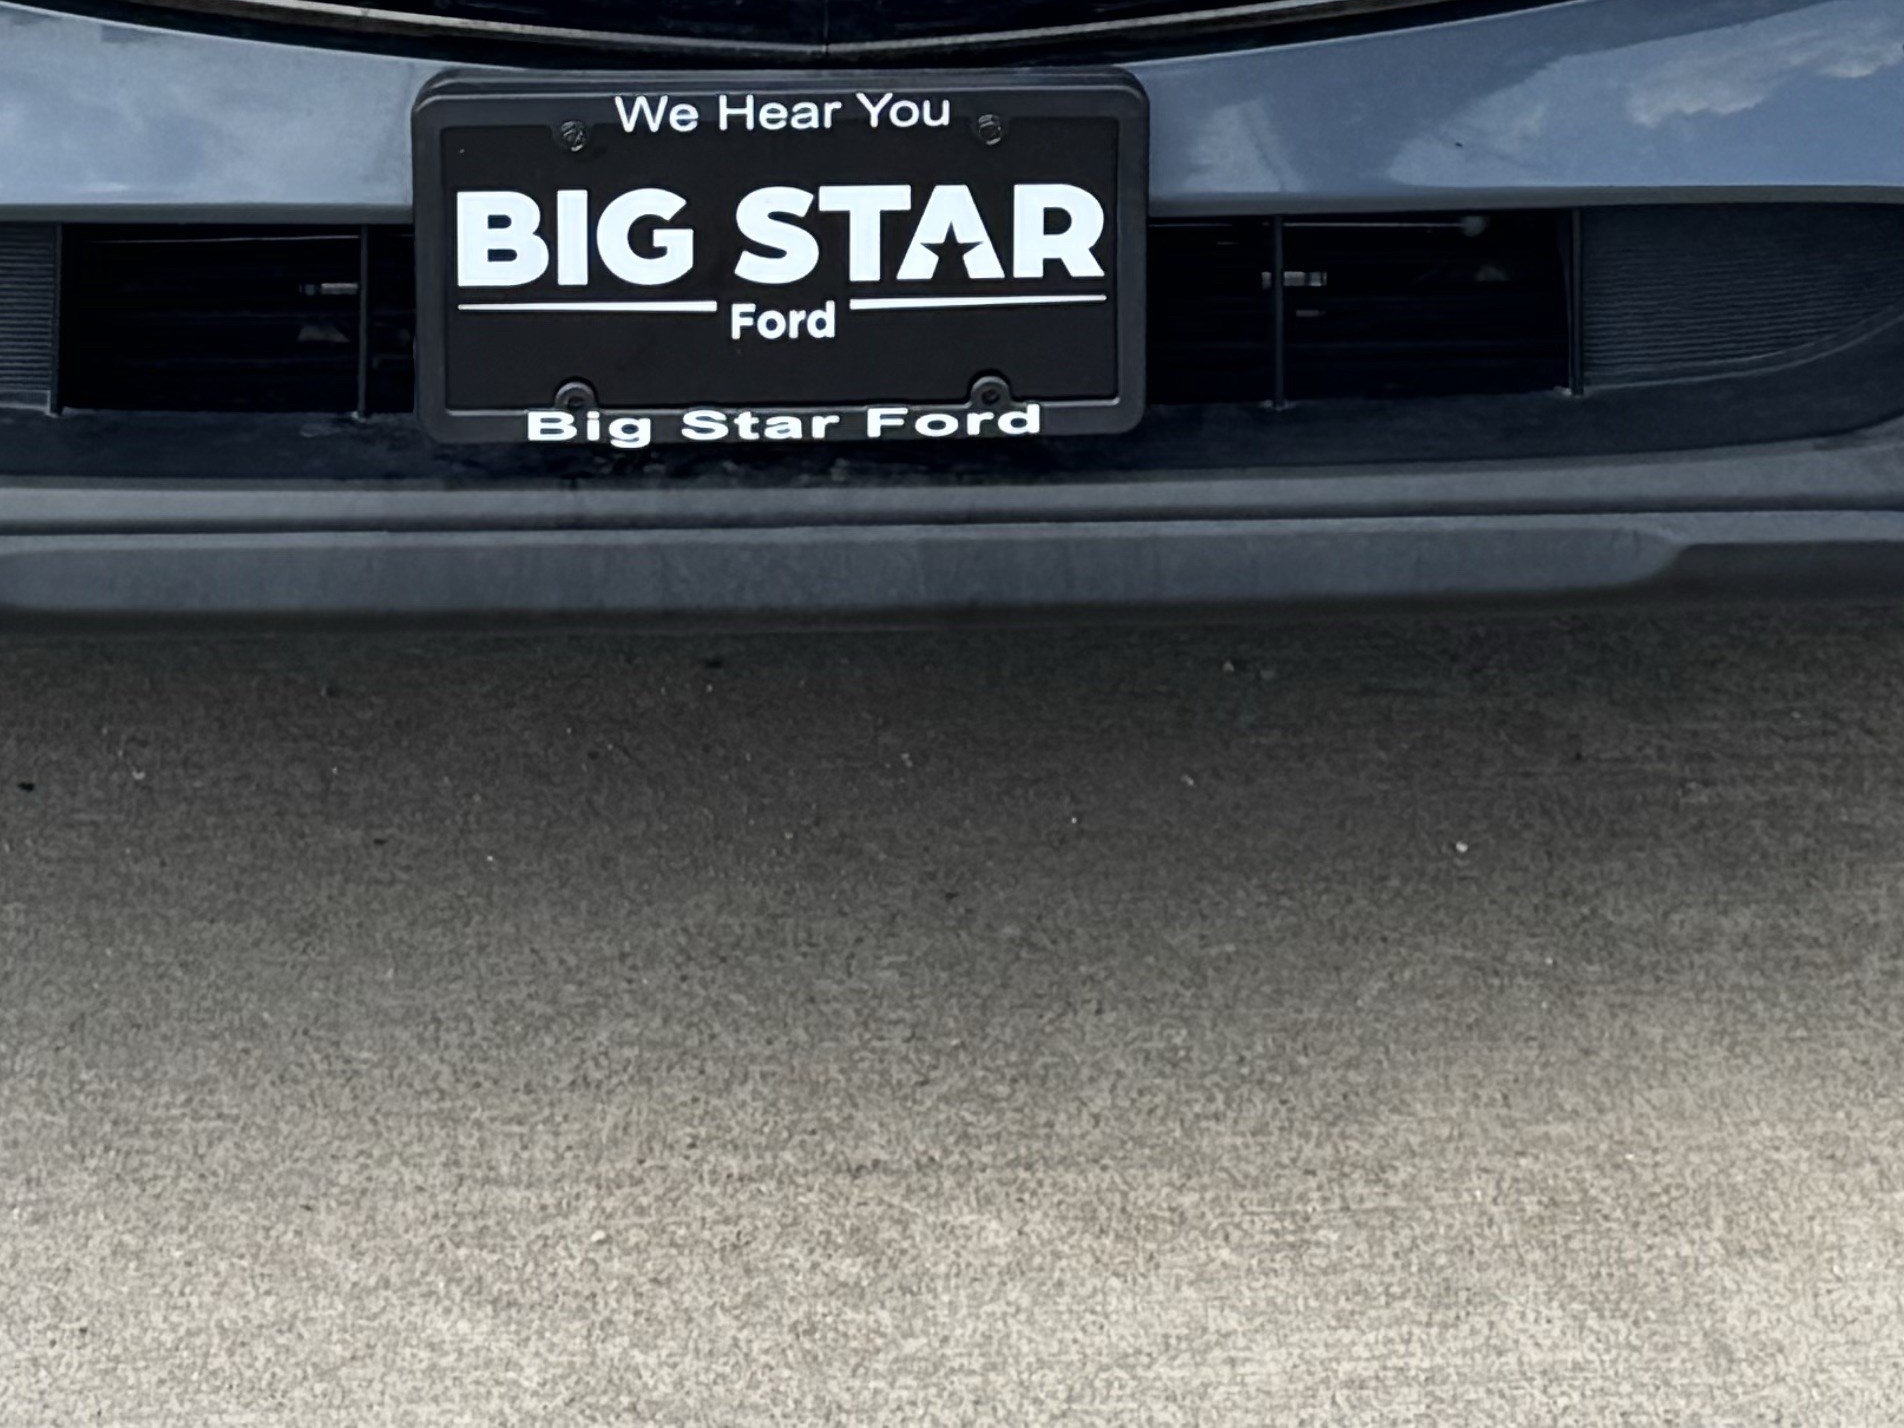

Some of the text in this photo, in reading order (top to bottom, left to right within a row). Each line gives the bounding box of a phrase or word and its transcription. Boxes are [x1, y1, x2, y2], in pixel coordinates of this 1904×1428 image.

[614, 92, 950, 133] We Hear You
[456, 183, 1105, 287] BIG STAR
[731, 300, 836, 340] Ford
[523, 403, 1041, 449] Big Star Ford
